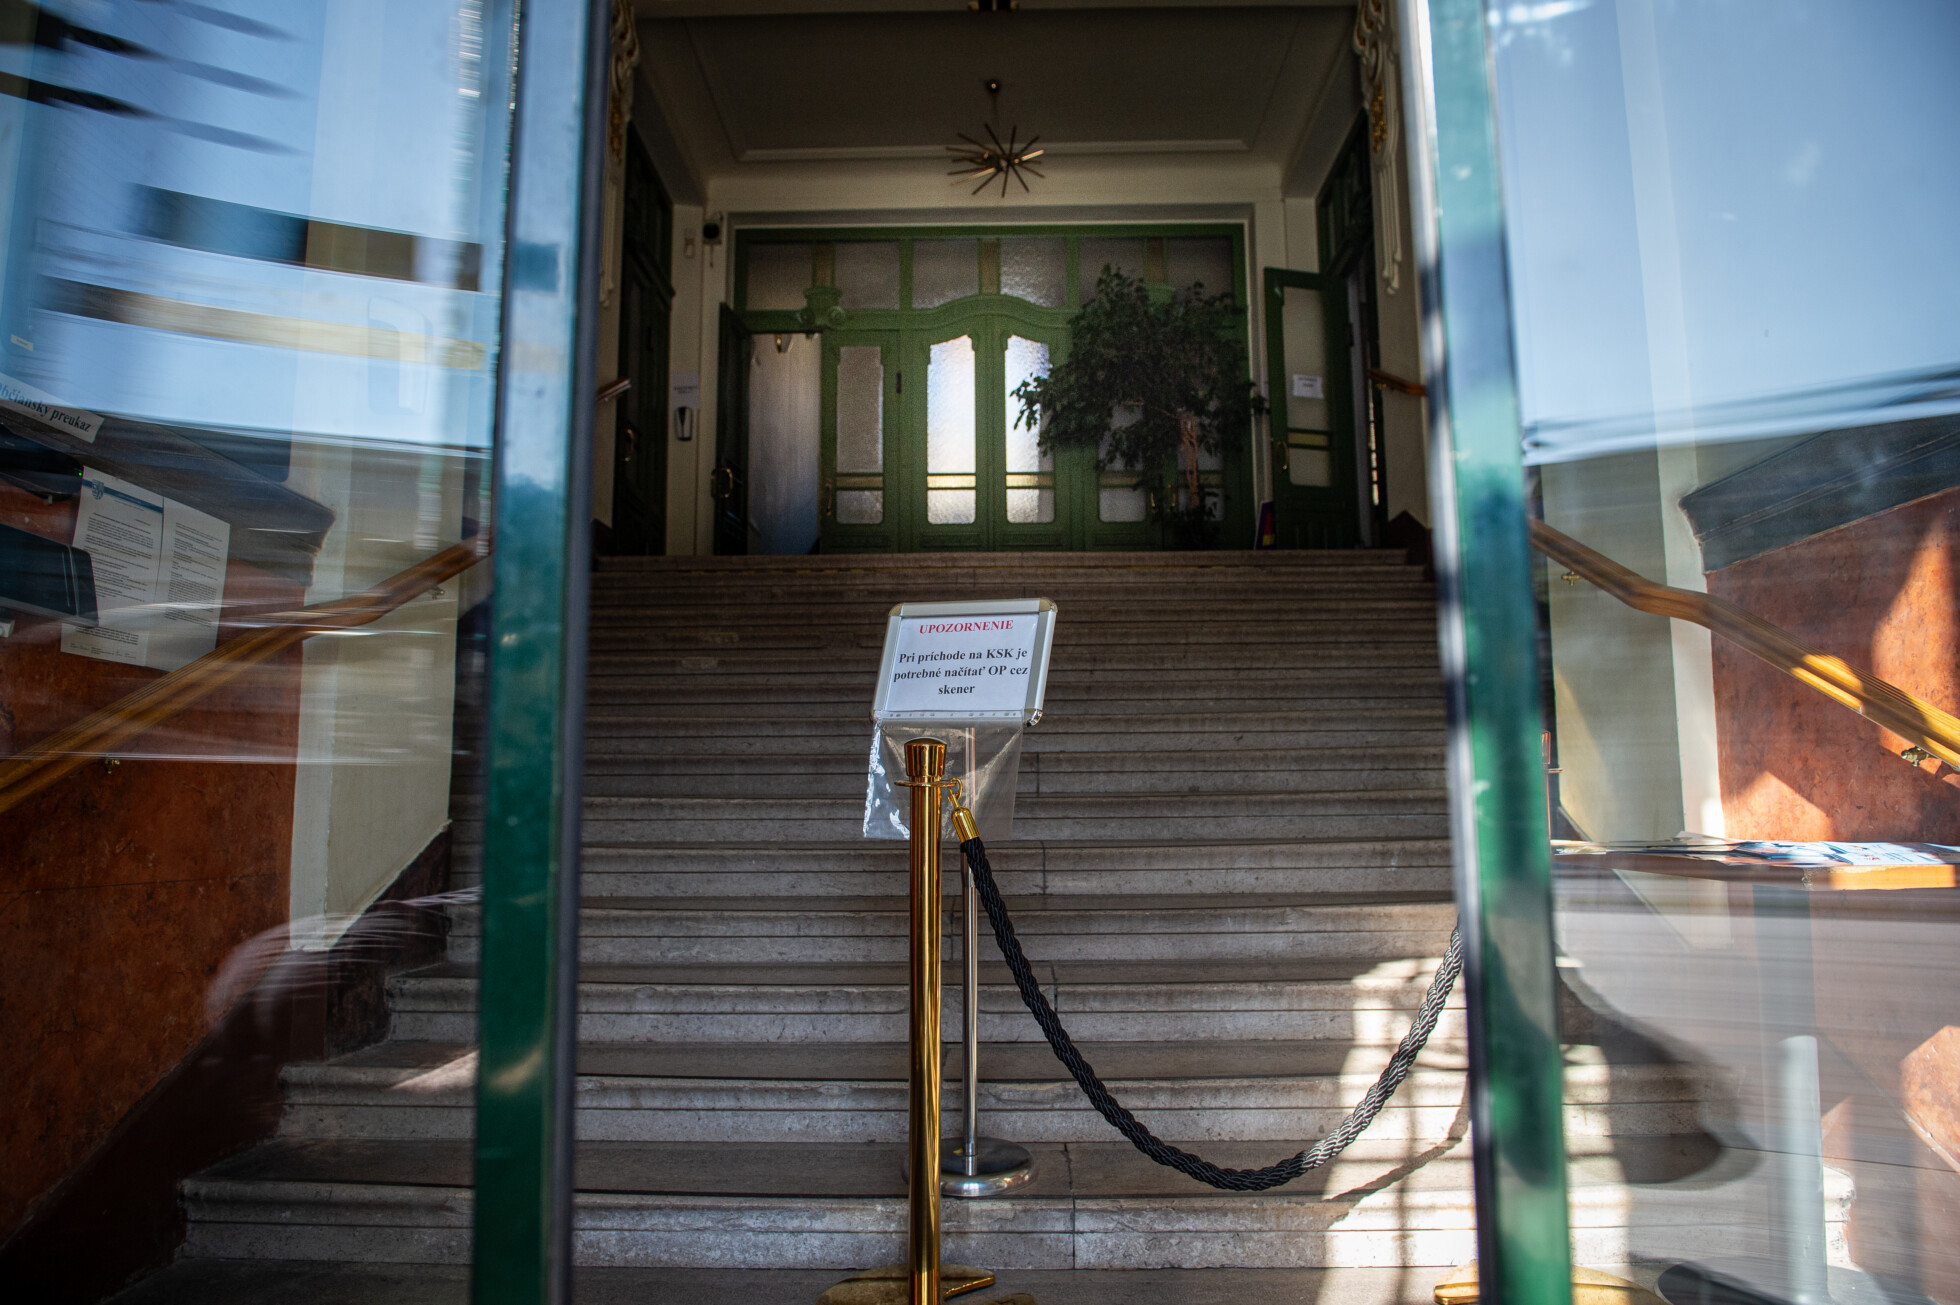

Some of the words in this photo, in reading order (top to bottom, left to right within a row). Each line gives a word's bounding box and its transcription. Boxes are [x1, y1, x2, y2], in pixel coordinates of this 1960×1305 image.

[0, 382, 51, 417] bčiansky
[50, 409, 92, 433] preukaz
[919, 620, 1014, 634] UPOZORNENIE
[899, 652, 916, 663] Pri
[917, 650, 966, 664] príchode
[968, 652, 983, 660] na
[986, 648, 1014, 659] KSK
[1015, 648, 1028, 660] je
[893, 668, 942, 682] potrebné
[944, 666, 986, 678] načítať
[988, 665, 1007, 676] OP
[1009, 666, 1028, 675] cez
[938, 684, 976, 695] skener
